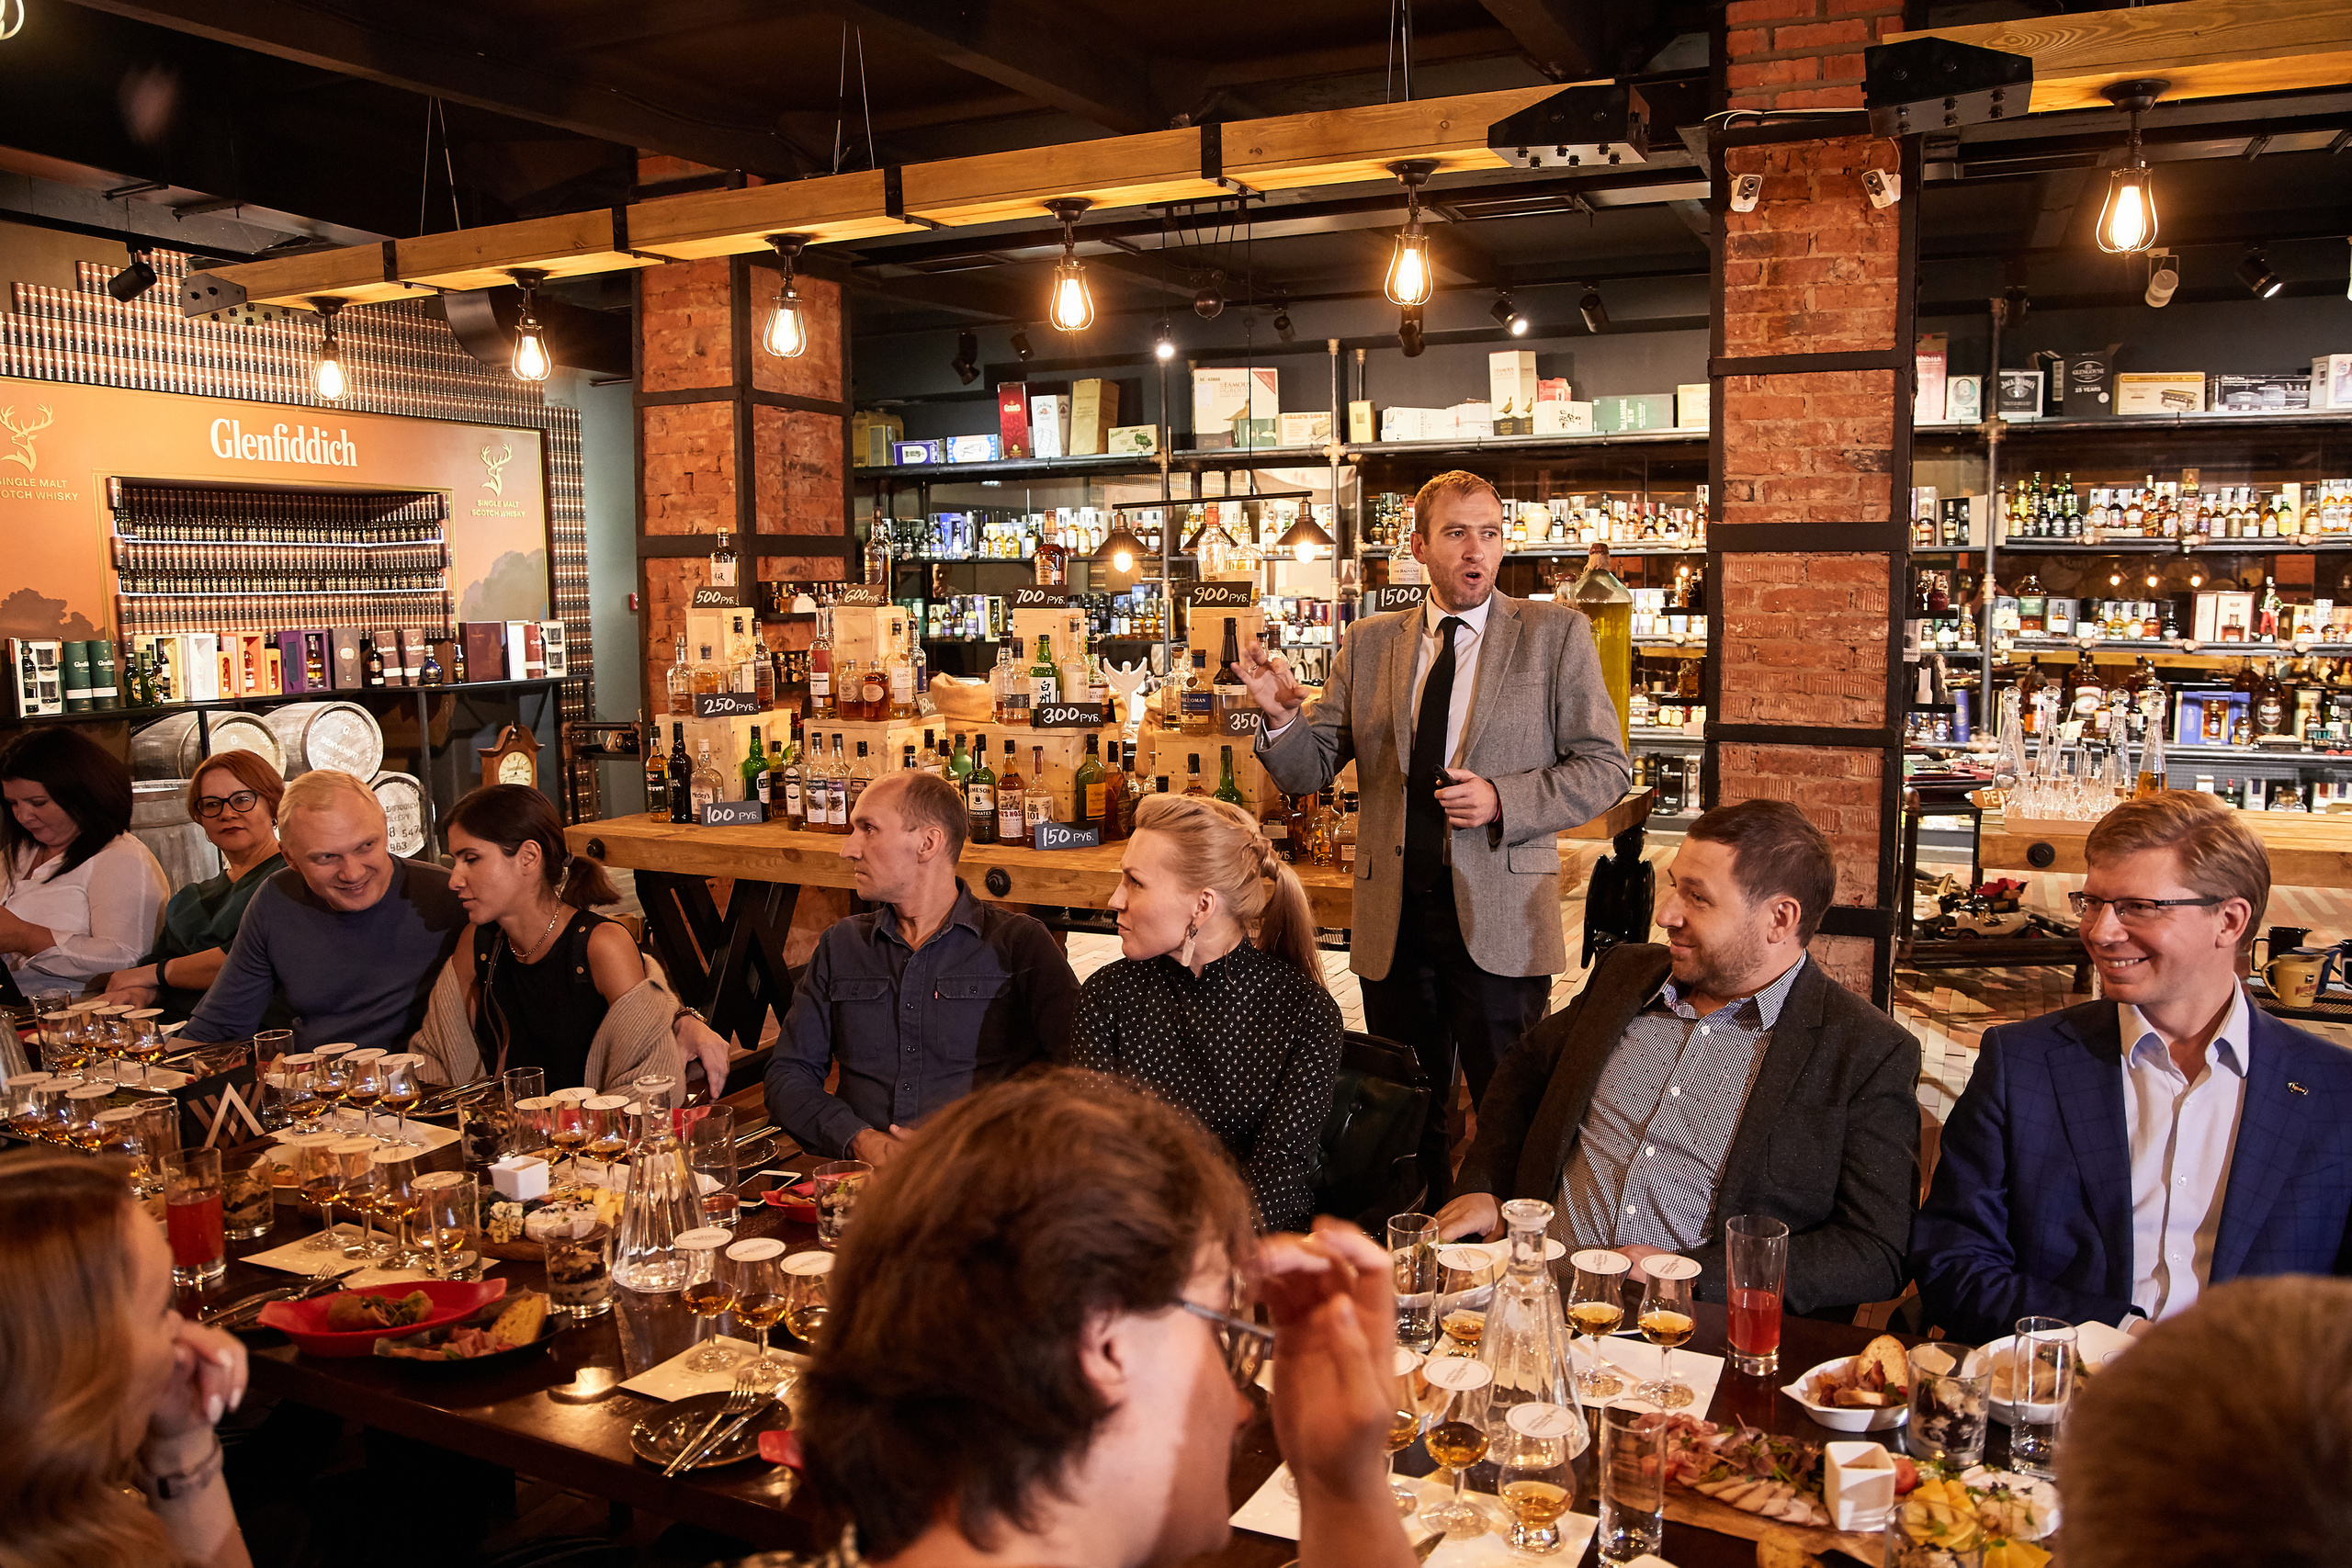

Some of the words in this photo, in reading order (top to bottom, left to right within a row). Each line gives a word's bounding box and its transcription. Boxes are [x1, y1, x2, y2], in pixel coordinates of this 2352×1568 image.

[2071, 367, 2105, 376] GLENGOYNE
[210, 418, 358, 467] Glenfiddich
[40, 479, 68, 489] MALT
[0, 490, 33, 500] OTCH
[35, 491, 79, 502] WHISKY
[477, 499, 502, 508] SINGLE
[503, 501, 520, 509] MALT
[470, 508, 499, 517] SCOTCH
[499, 510, 526, 518] WHISKY
[695, 590, 722, 604] 500
[844, 589, 869, 604] 600
[1016, 589, 1046, 604] 700
[1193, 586, 1229, 604] 900
[1380, 587, 1422, 608] 1500
[1039, 680, 1052, 704] 白州
[704, 697, 736, 715] 250
[1042, 706, 1080, 724] 300
[1229, 713, 1261, 731] 350
[343, 725, 351, 736] G
[230, 734, 238, 745] G
[320, 736, 359, 761] BENVENUTI
[707, 806, 735, 824] 100
[1026, 812, 1040, 820] 101
[1043, 827, 1070, 847] 150
